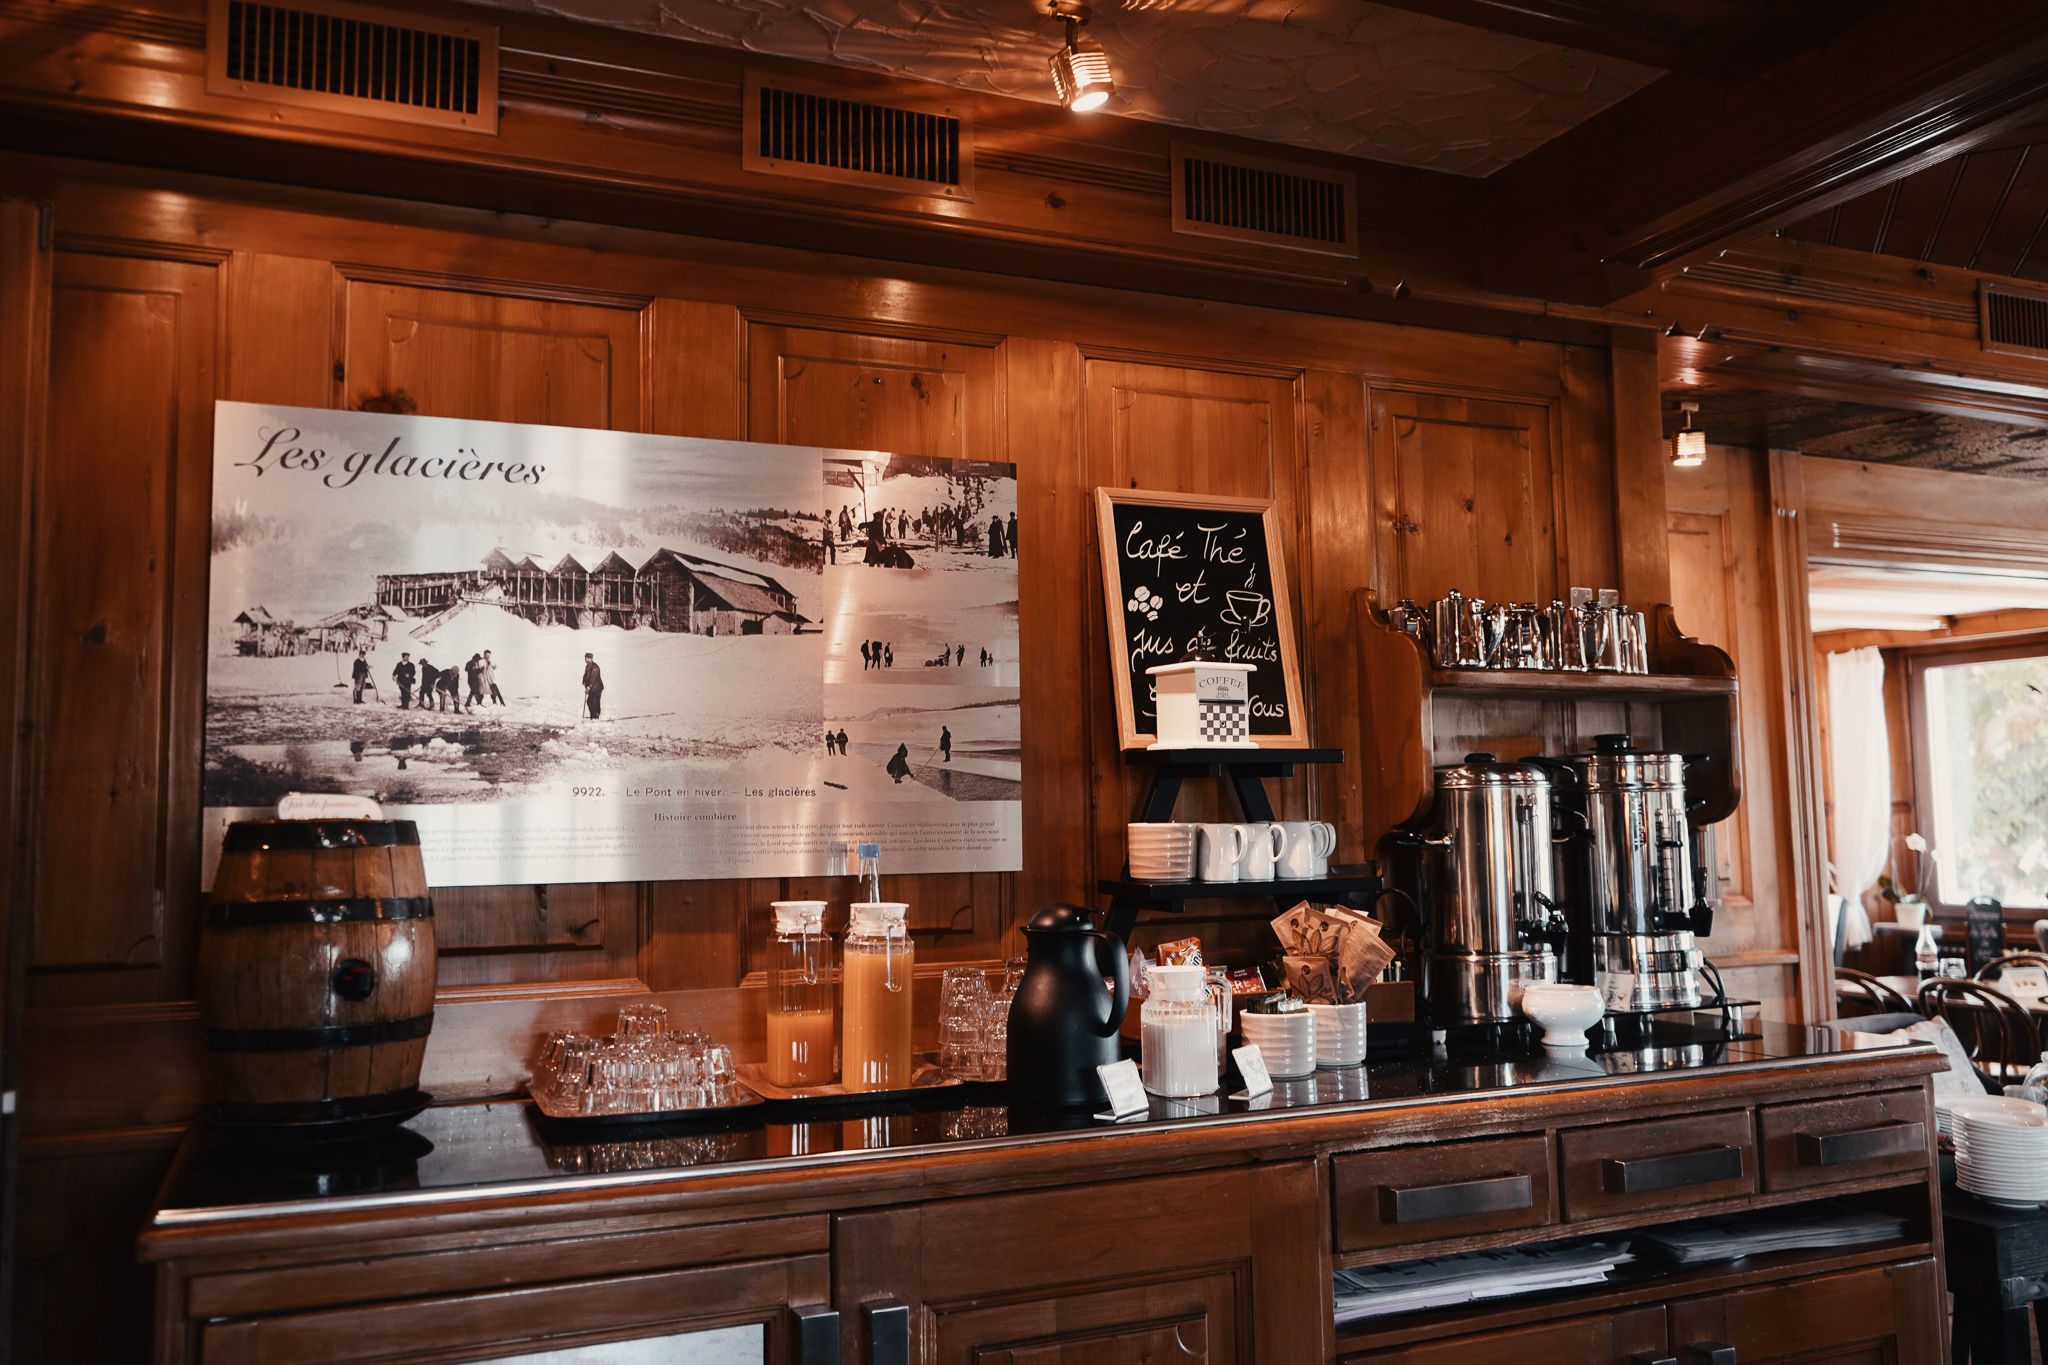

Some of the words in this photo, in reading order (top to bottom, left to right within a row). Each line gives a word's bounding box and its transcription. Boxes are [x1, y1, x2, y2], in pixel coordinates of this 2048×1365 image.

[233, 426, 334, 478] Les
[323, 437, 551, 489] glacières
[1125, 520, 1189, 578] Café
[1197, 522, 1247, 564] Thé
[1175, 569, 1210, 604] et
[1224, 628, 1278, 663] fruits
[1199, 676, 1245, 691] COFFEE
[572, 787, 605, 797] 9922.
[626, 787, 640, 797] Le
[645, 787, 671, 797] Pont
[676, 789, 689, 797] en
[694, 787, 725, 797] hiver.
[745, 787, 764, 797] Les
[768, 786, 816, 799] glacières
[307, 798, 320, 809] de
[321, 799, 360, 813] pomme
[654, 813, 692, 821] Histoire
[694, 812, 737, 821] combière
[725, 823, 755, 832] apercevant
[819, 822, 841, 830] plaignit
[967, 820, 978, 829] plus
[979, 820, 995, 828] grand
[761, 830, 797, 839] comparaison
[888, 829, 898, 838] qui
[976, 827, 988, 836] scie,
[782, 838, 802, 847] anglais
[772, 847, 798, 856] quelques
